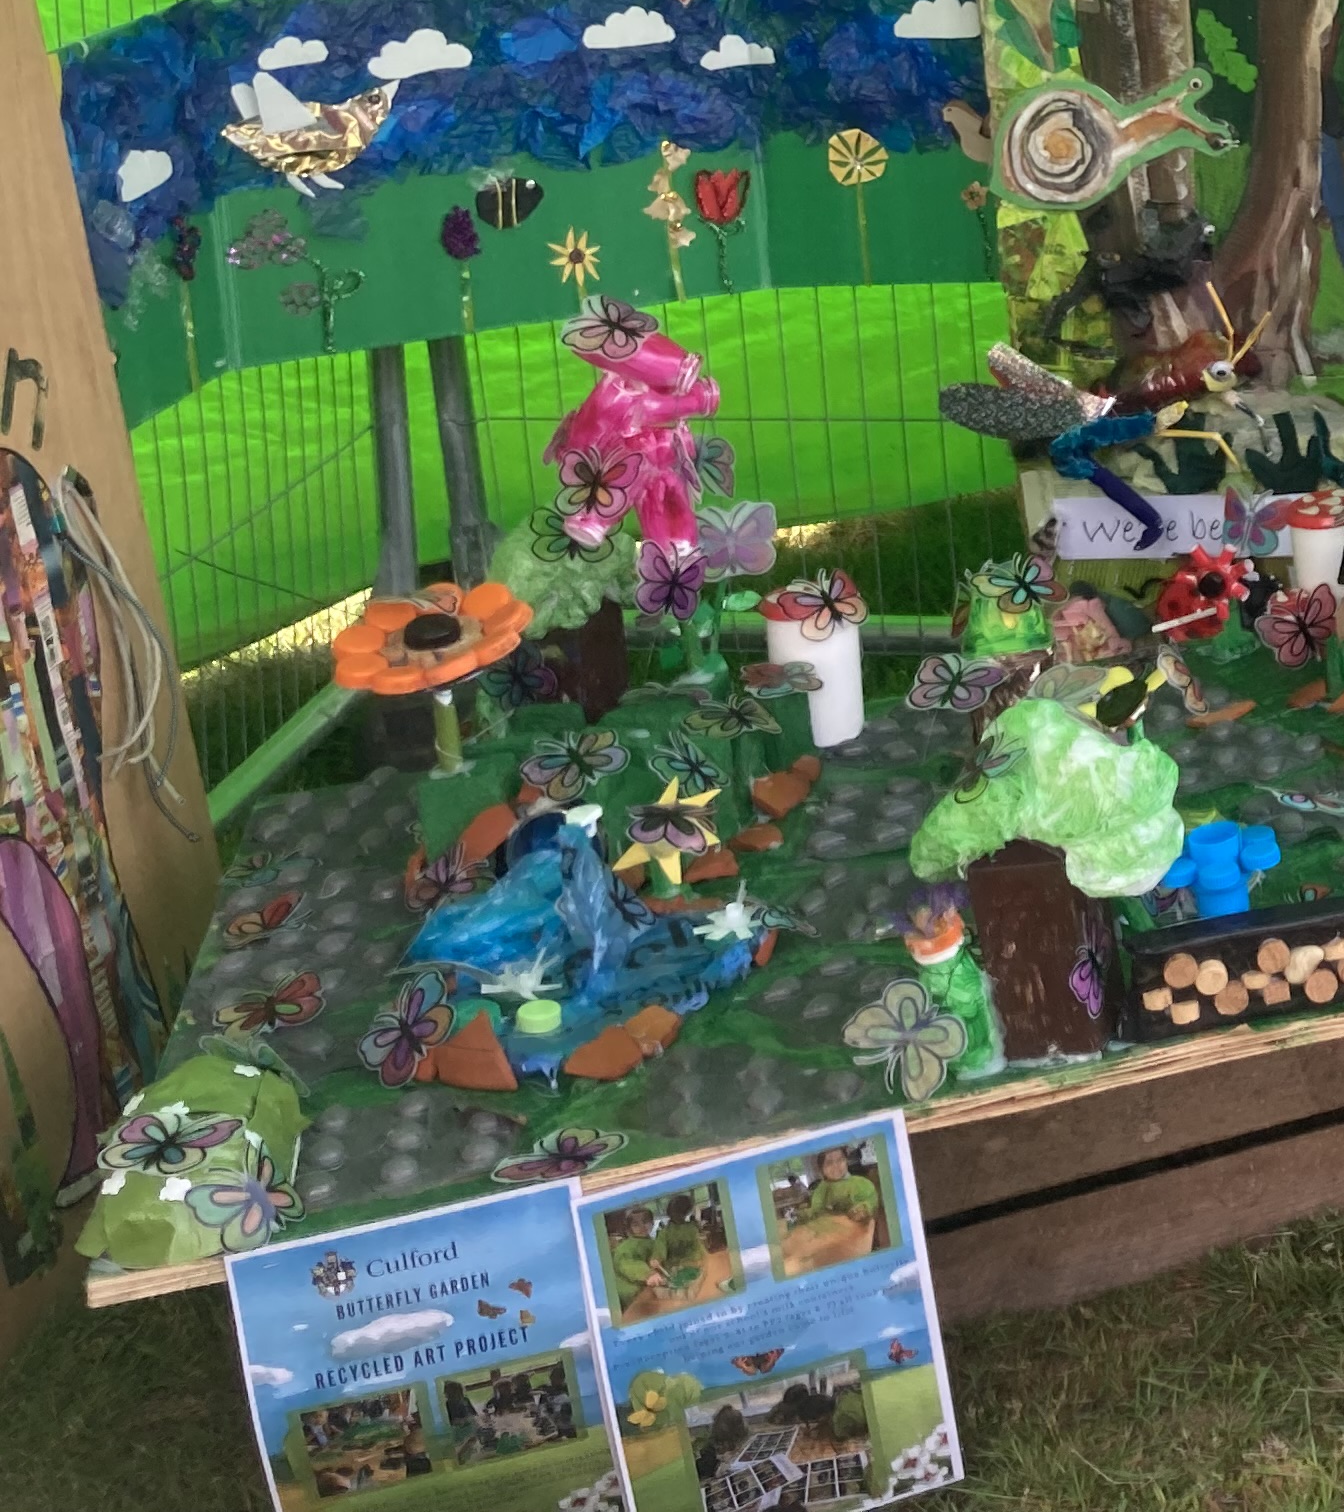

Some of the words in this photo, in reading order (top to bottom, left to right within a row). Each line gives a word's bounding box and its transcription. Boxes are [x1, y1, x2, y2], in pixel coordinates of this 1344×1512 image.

[366, 1240, 460, 1278] Culford
[335, 1287, 421, 1321] BUTTERFLY
[429, 1271, 490, 1300] GARDEN
[315, 1355, 404, 1390] RECYCLED
[413, 1344, 447, 1369] ART
[455, 1325, 529, 1359] PROJECT
